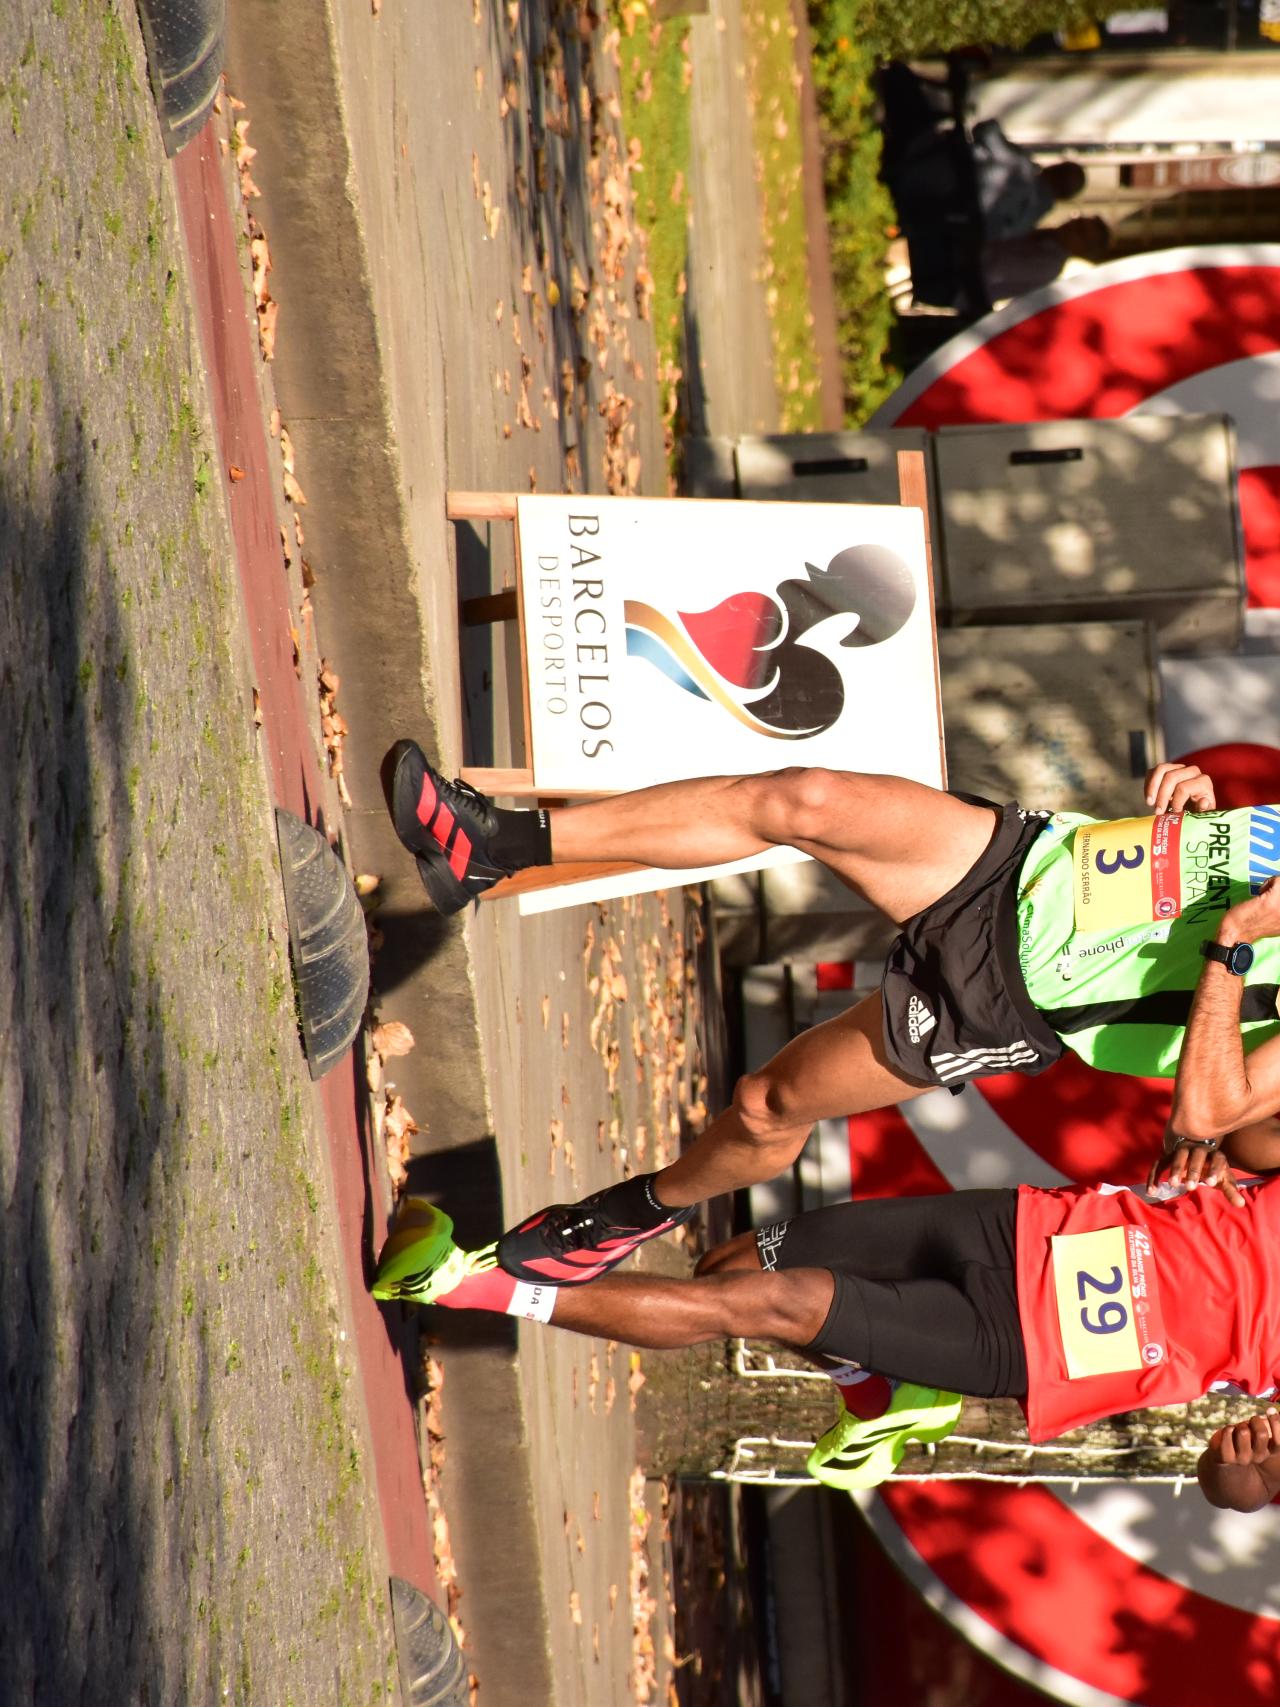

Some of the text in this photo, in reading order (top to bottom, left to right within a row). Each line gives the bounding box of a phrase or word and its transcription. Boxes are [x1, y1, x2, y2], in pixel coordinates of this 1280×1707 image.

[537, 555, 568, 717] DESPORTO
[567, 514, 615, 759] BARCELOS
[1081, 833, 1091, 905] FERNANDO SERRÃO
[1095, 844, 1145, 875] 3
[1186, 840, 1209, 925] SPRAIN
[1208, 822, 1231, 911] PREVENT
[908, 995, 920, 1044] adidas
[1136, 1248, 1145, 1274] GRANDE
[1077, 1266, 1128, 1335] 29
